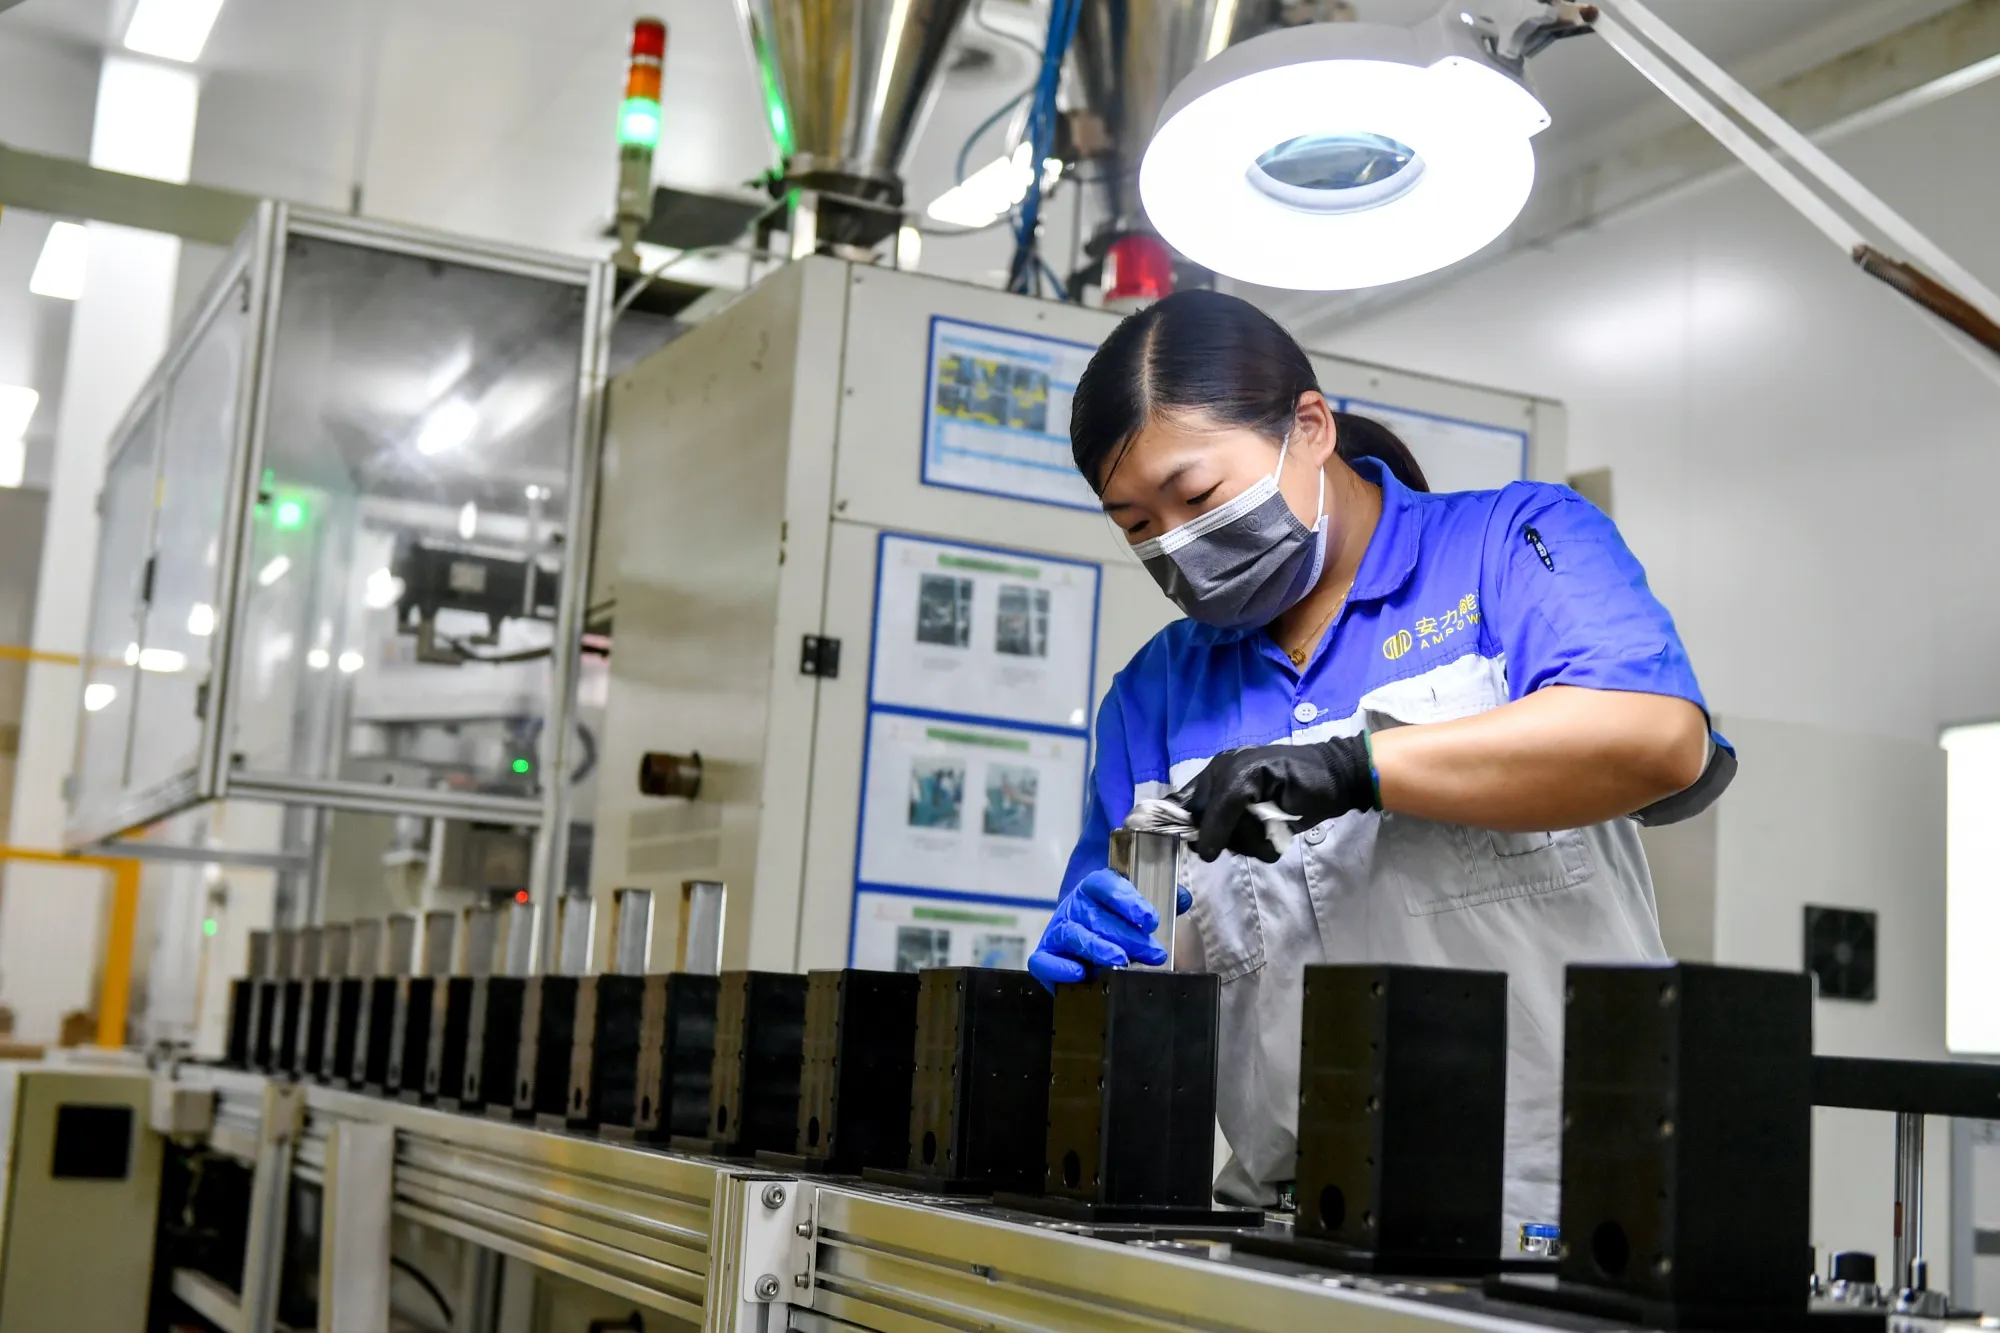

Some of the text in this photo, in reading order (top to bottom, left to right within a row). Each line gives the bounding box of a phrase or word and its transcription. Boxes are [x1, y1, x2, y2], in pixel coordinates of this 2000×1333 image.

[1415, 589, 1479, 637] 安力能
[1421, 612, 1481, 650] AMPOW
